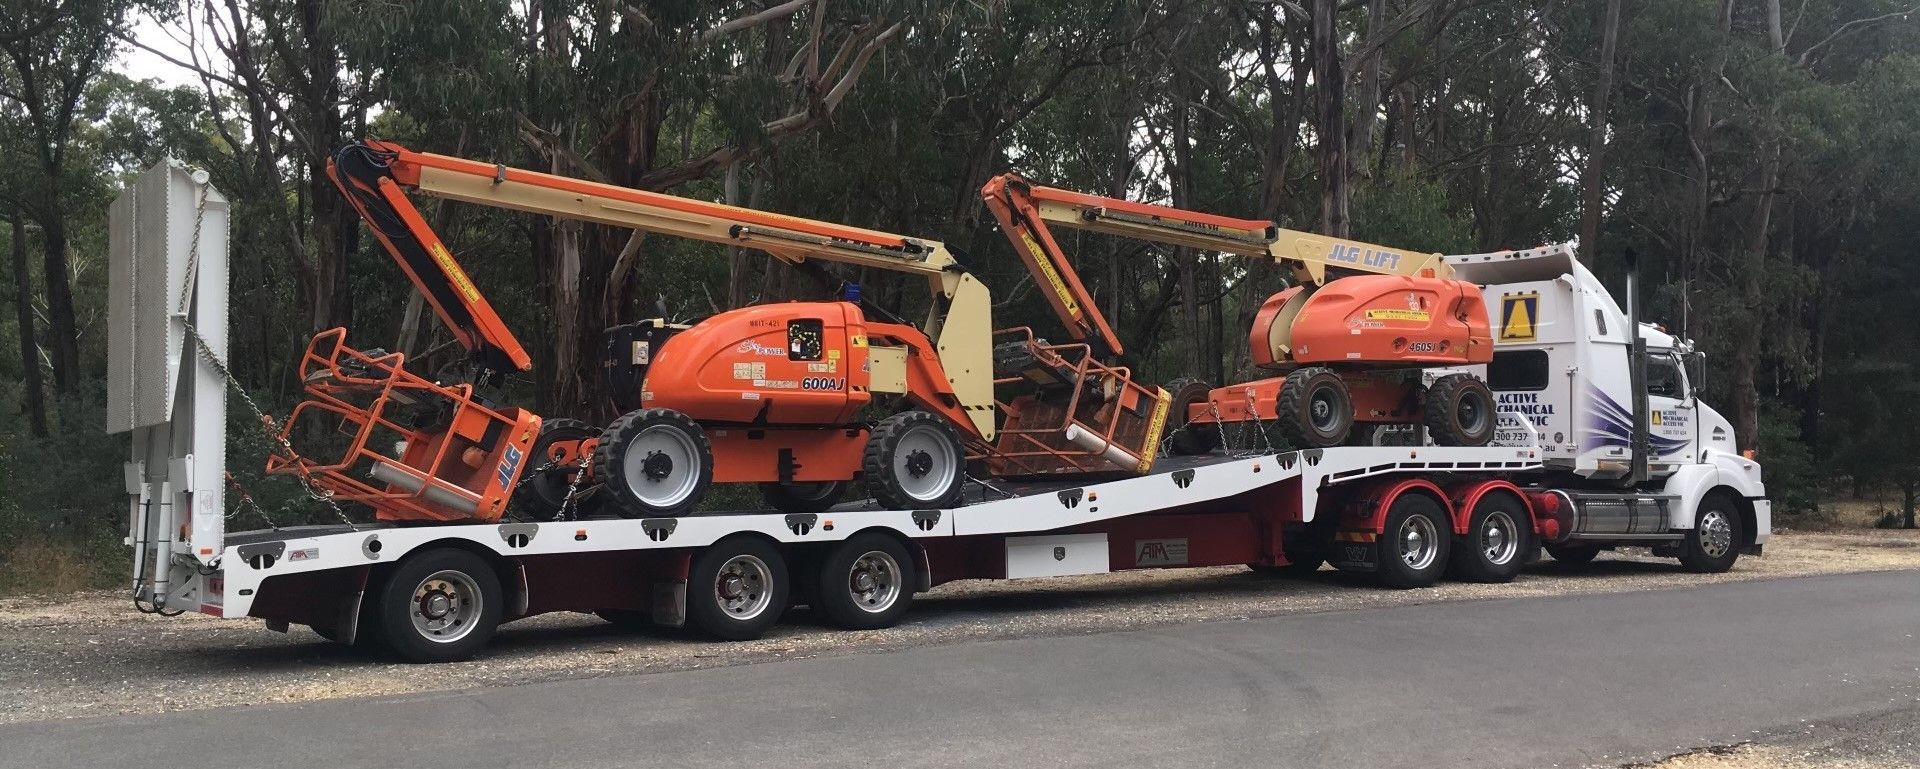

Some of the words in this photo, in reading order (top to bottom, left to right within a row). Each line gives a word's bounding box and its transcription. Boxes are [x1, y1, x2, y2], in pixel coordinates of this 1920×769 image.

[1327, 243, 1361, 263] JLG
[1362, 248, 1402, 270] LIFT
[802, 377, 846, 391] 600AJ
[1498, 393, 1538, 404] ACTIVE
[1496, 404, 1555, 415] CHANICAL
[1529, 416, 1549, 426] VIC
[1495, 432, 1511, 441] 300
[1512, 432, 1528, 441] 737
[498, 442, 524, 494] JLG
